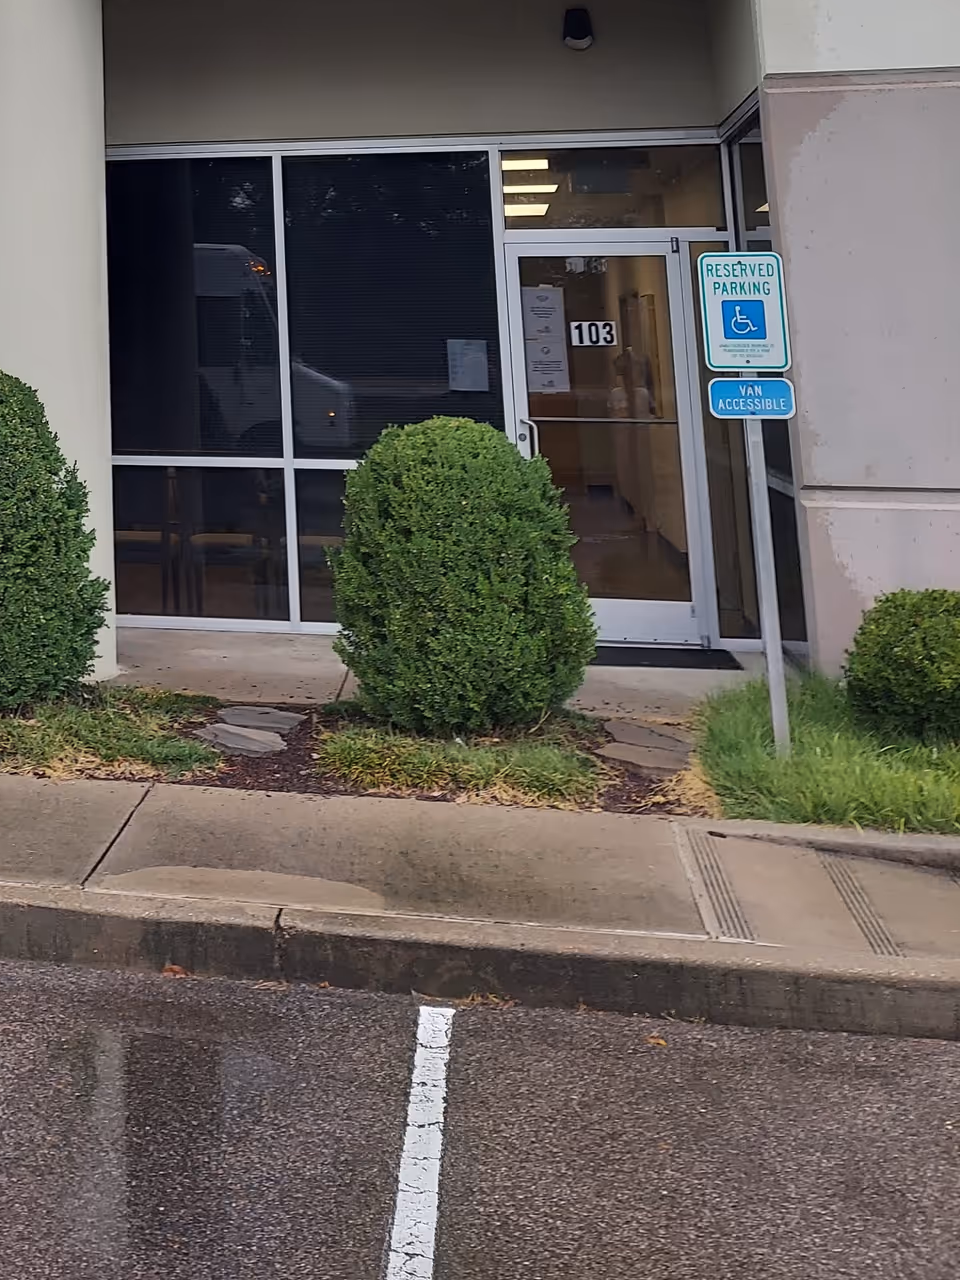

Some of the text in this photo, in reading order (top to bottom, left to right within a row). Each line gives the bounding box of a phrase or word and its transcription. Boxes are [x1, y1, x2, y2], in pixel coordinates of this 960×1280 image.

[706, 263, 775, 278] RESERVED
[713, 281, 771, 296] PARKING
[574, 322, 615, 345] 103
[739, 385, 763, 397] VAN
[718, 398, 787, 411] ACCESSIBLE
